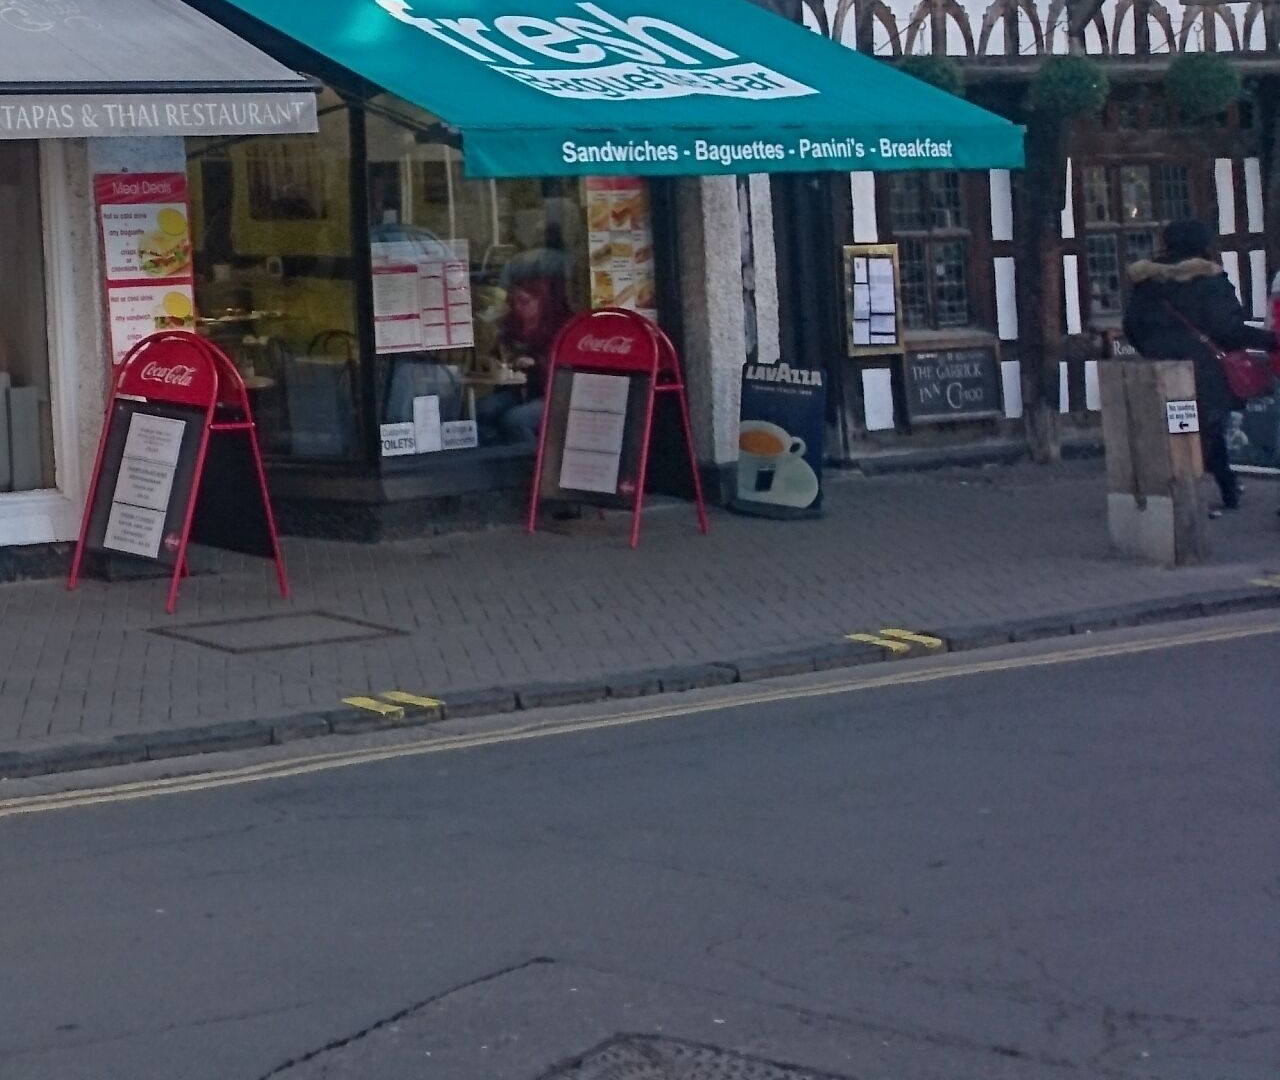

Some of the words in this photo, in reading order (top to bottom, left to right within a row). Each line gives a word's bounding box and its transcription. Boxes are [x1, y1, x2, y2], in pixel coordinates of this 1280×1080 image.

[696, 71, 788, 94] Bar
[1, 104, 74, 129] TAPAS
[81, 104, 98, 128] &
[103, 103, 159, 128] THAI
[166, 101, 305, 126] RESTAURANT
[562, 140, 678, 163] Sandwiches
[695, 140, 785, 165] Baguettes
[799, 138, 865, 159] Panini's
[879, 137, 952, 158] Breakfast
[112, 182, 139, 195] Meal
[142, 181, 171, 194] Deals
[746, 362, 822, 386] LAVAZZA
